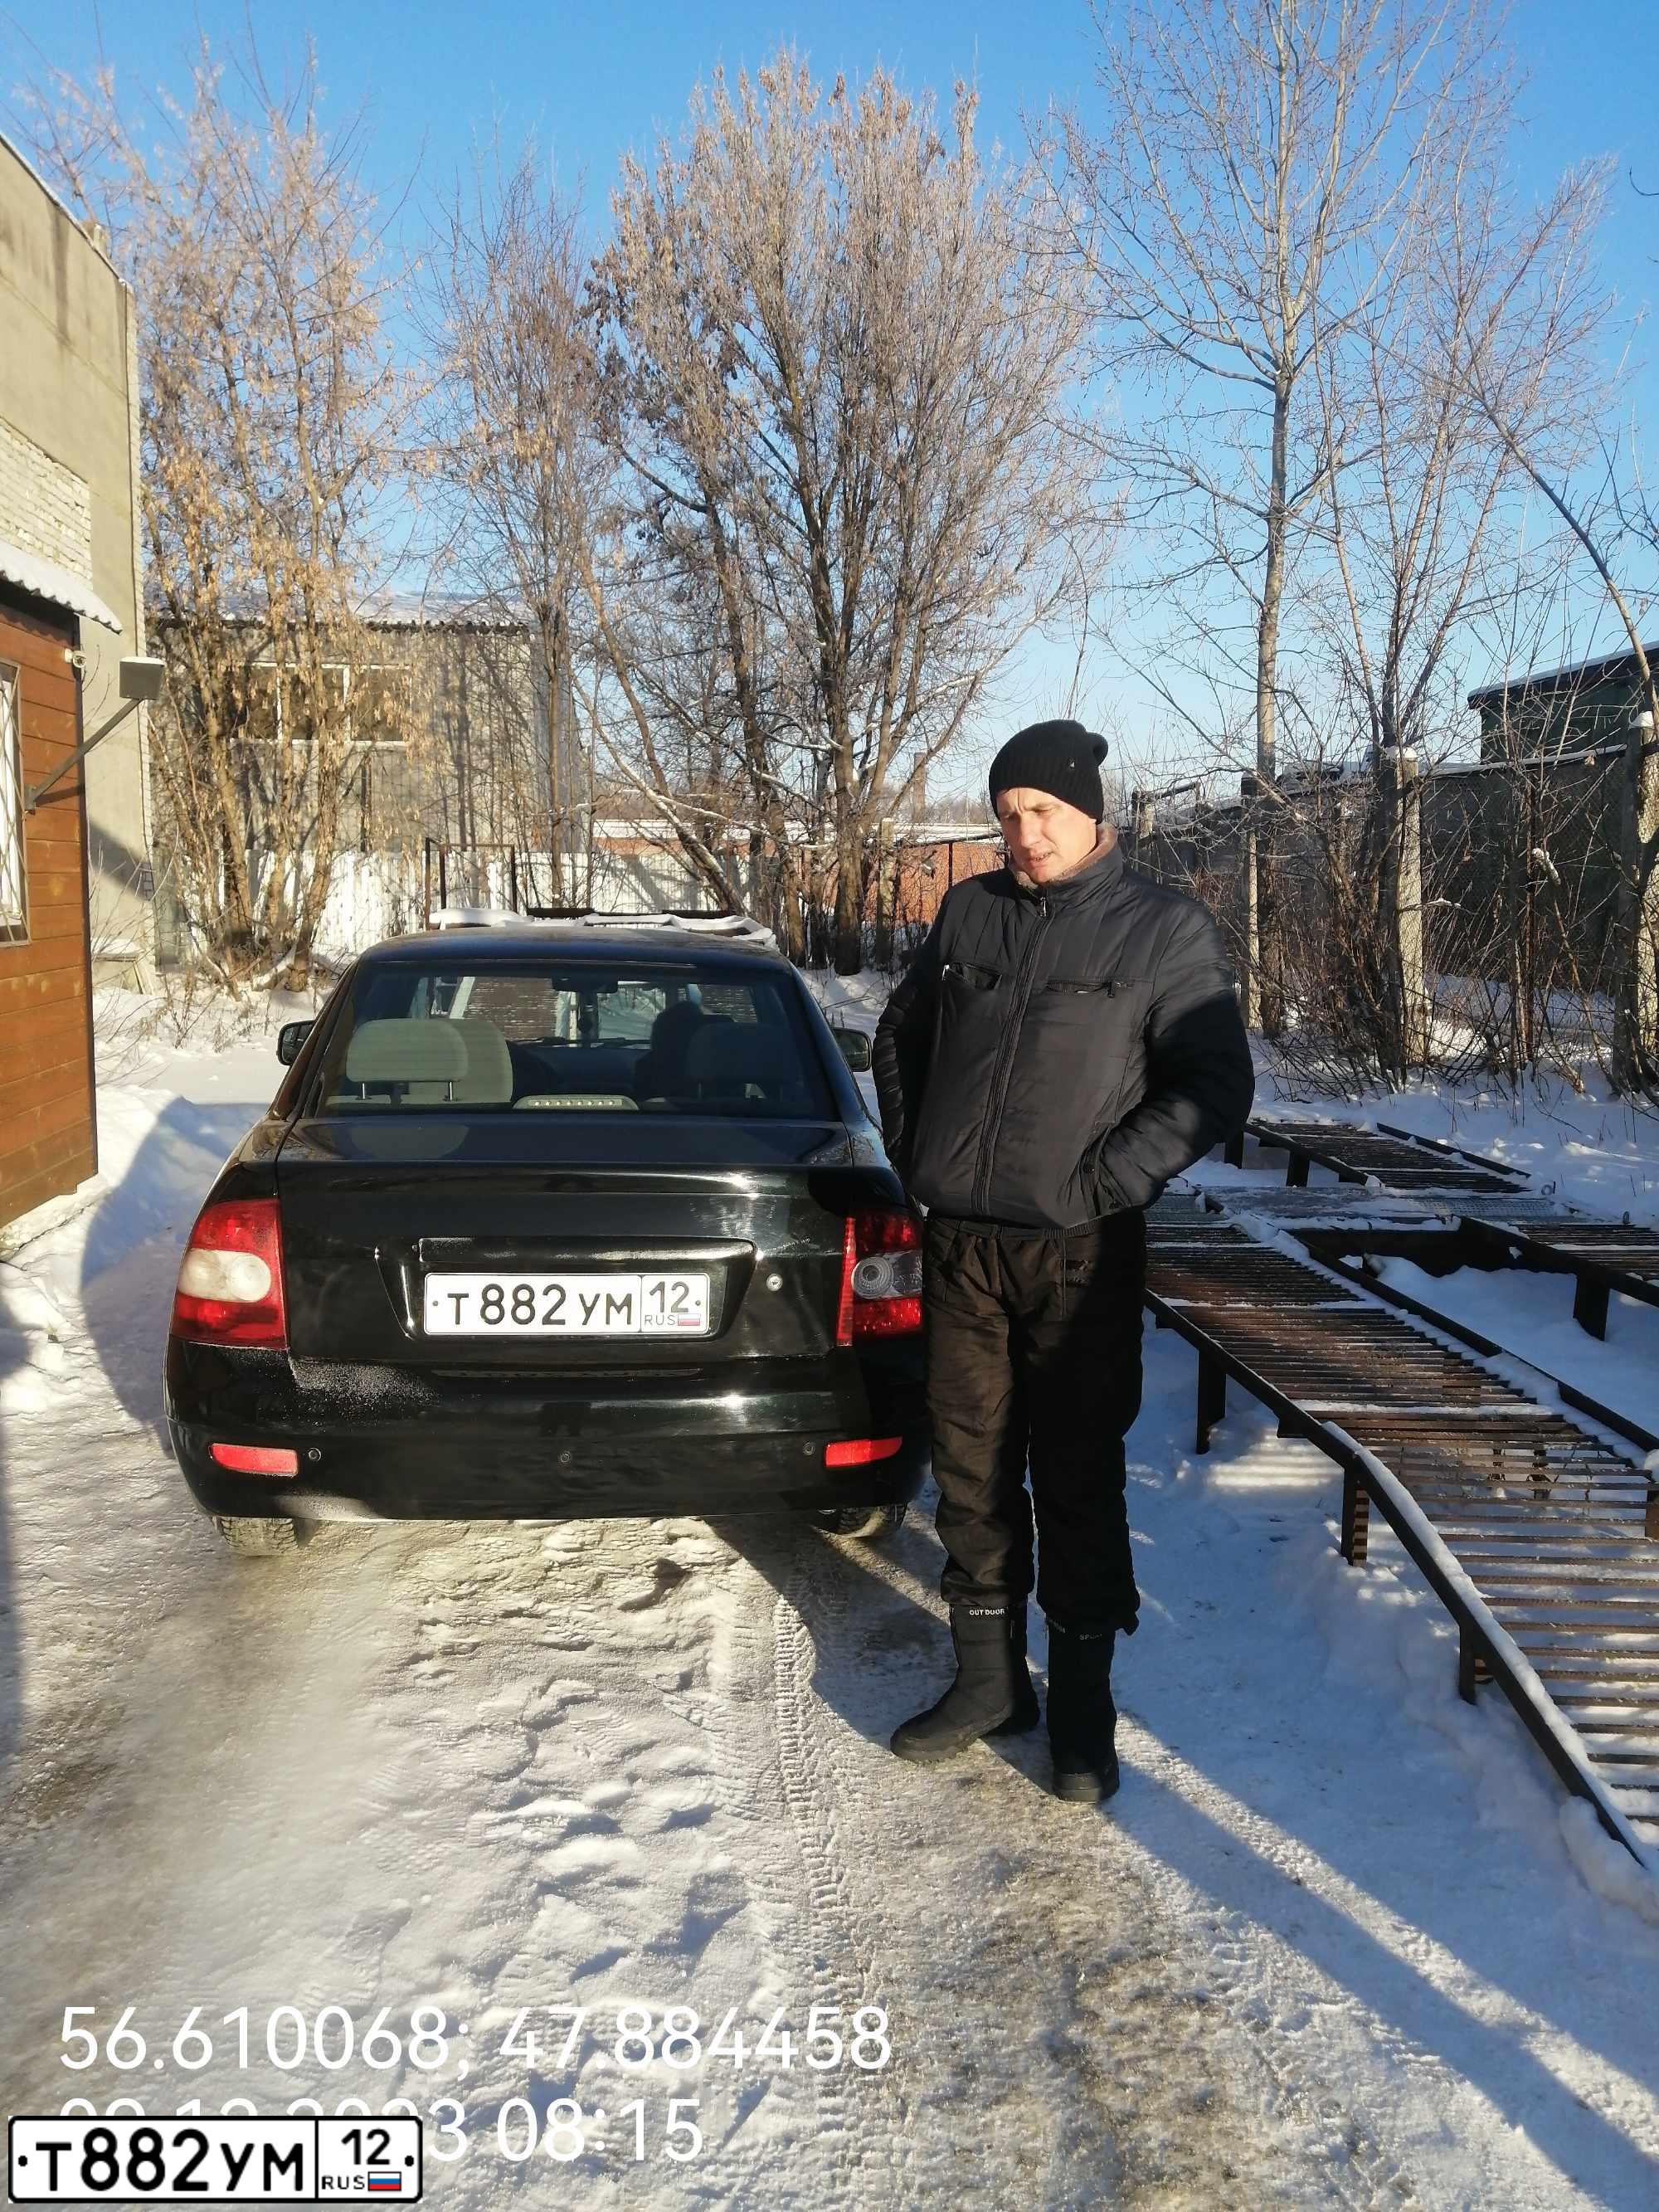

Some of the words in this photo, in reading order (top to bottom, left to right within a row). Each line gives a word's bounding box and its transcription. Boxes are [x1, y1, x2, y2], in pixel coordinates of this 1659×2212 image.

[447, 1283, 632, 1326] Т882УМ
[649, 1280, 689, 1313] 12
[645, 1314, 675, 1326] RUS
